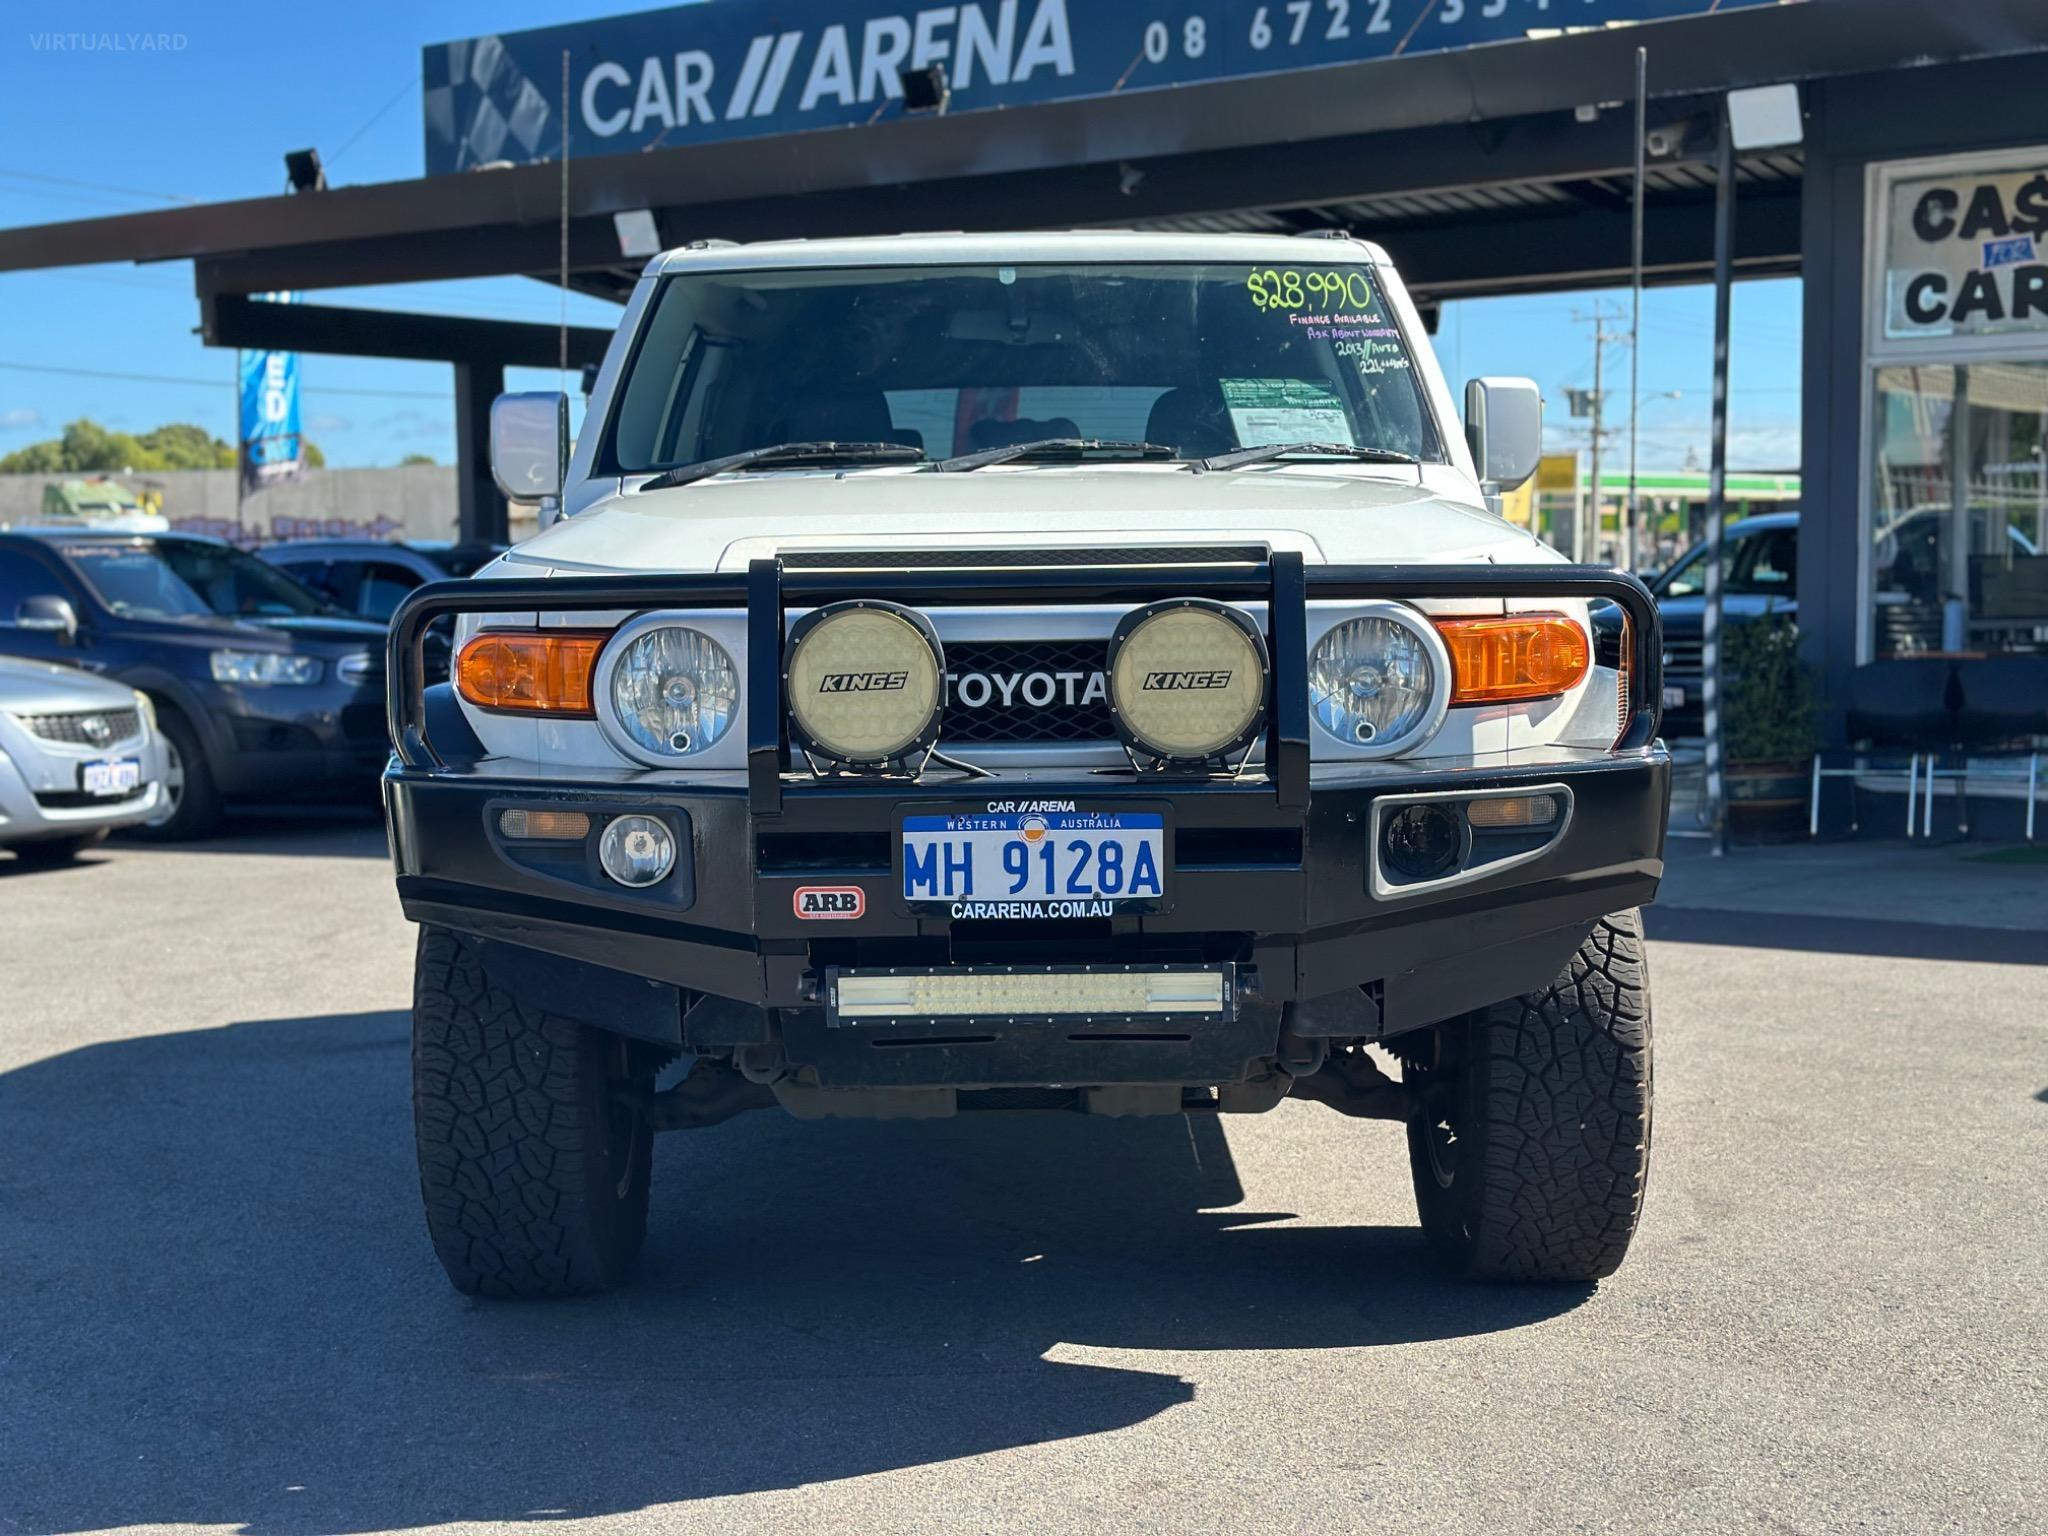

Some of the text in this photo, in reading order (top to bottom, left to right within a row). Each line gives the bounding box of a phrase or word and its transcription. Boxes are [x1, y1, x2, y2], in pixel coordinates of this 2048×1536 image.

[1144, 17, 1206, 63] 08
[1249, 0, 1391, 49] 6722
[580, 57, 715, 137] CAR
[1247, 267, 1370, 312] $28,990
[1289, 314, 1331, 325] FINANCE
[1307, 327, 1330, 339] ASK
[1332, 328, 1359, 340] ABOUT
[820, 671, 908, 693] KINGS
[1143, 670, 1233, 690] KINGS
[987, 801, 1015, 813] CAR
[1026, 801, 1076, 813] ARENA
[947, 818, 1121, 830] WESTERN AUSTRALIA
[904, 840, 1162, 897] MH 9128A
[803, 894, 857, 911] ARB
[951, 901, 1114, 919] CARARENA.COM.AU
